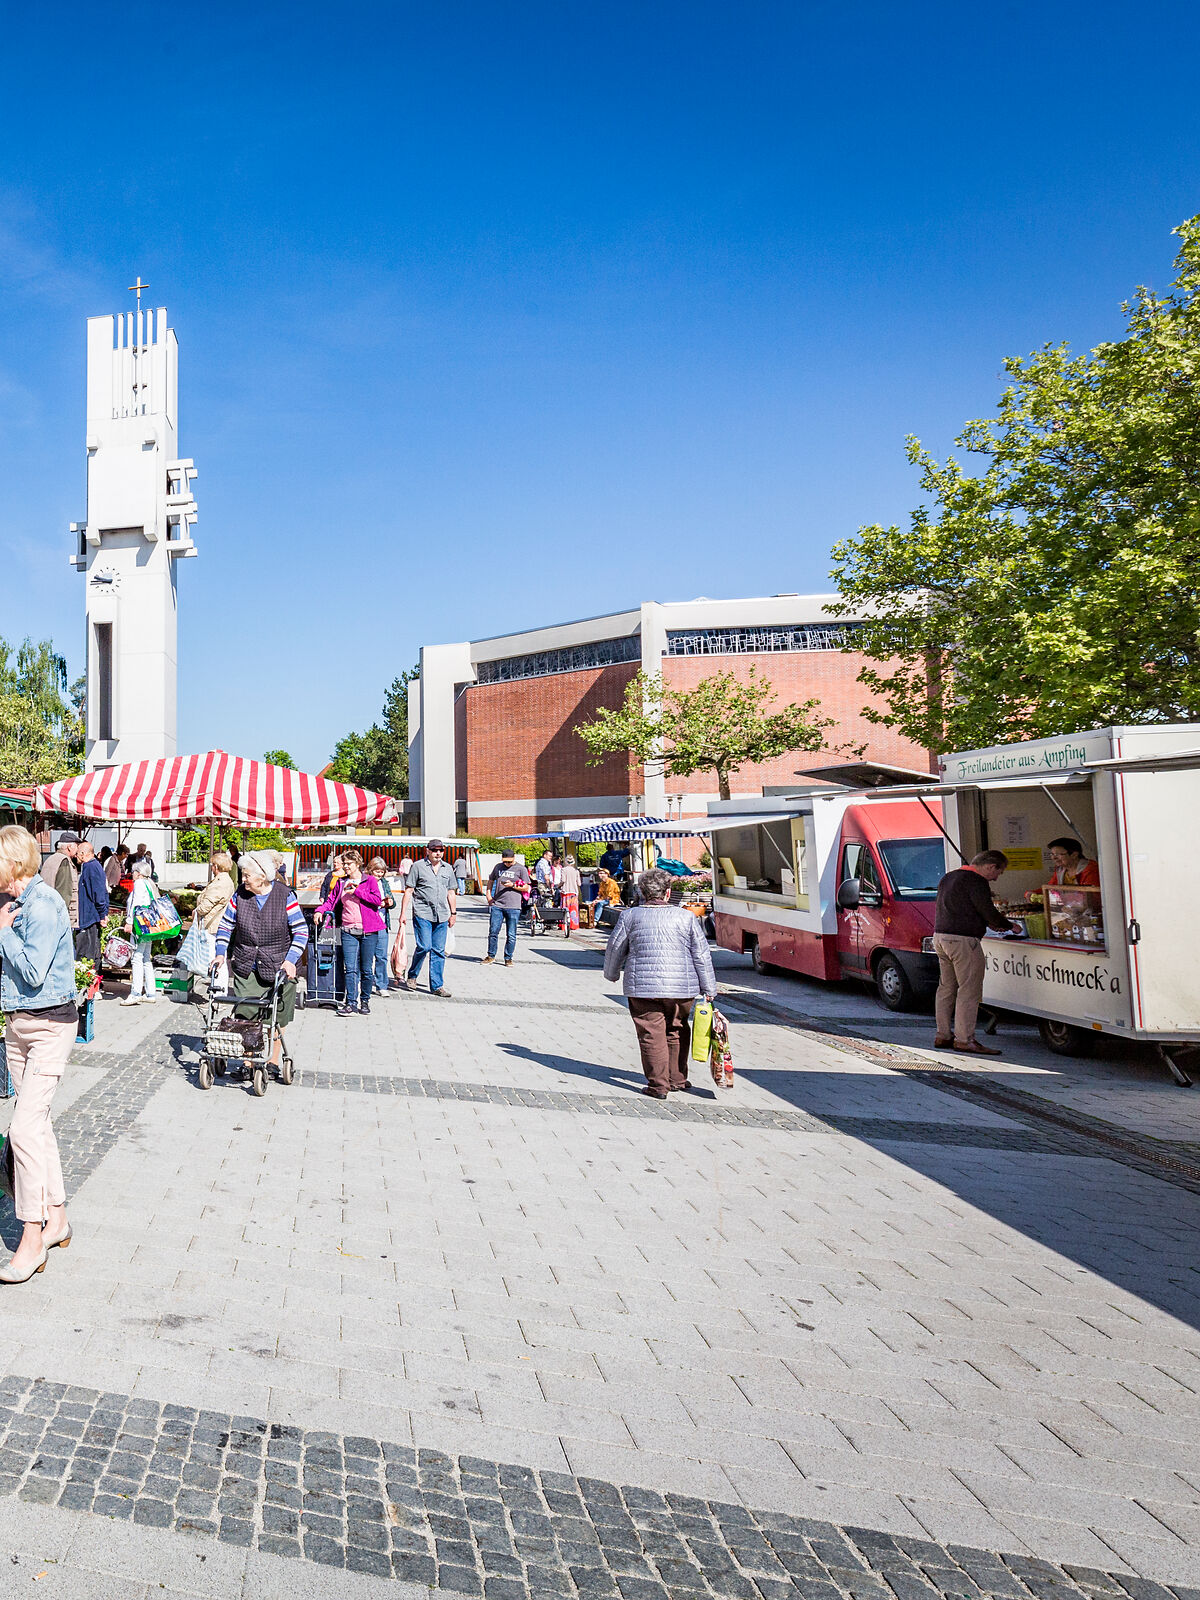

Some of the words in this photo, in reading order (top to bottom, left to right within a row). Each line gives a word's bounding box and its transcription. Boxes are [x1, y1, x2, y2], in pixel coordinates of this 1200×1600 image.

[957, 755, 1016, 780] Freilandeier
[1018, 754, 1035, 767] aus
[1038, 743, 1088, 769] Ampfing
[498, 870, 516, 879] VANS
[1003, 953, 1031, 978] eich
